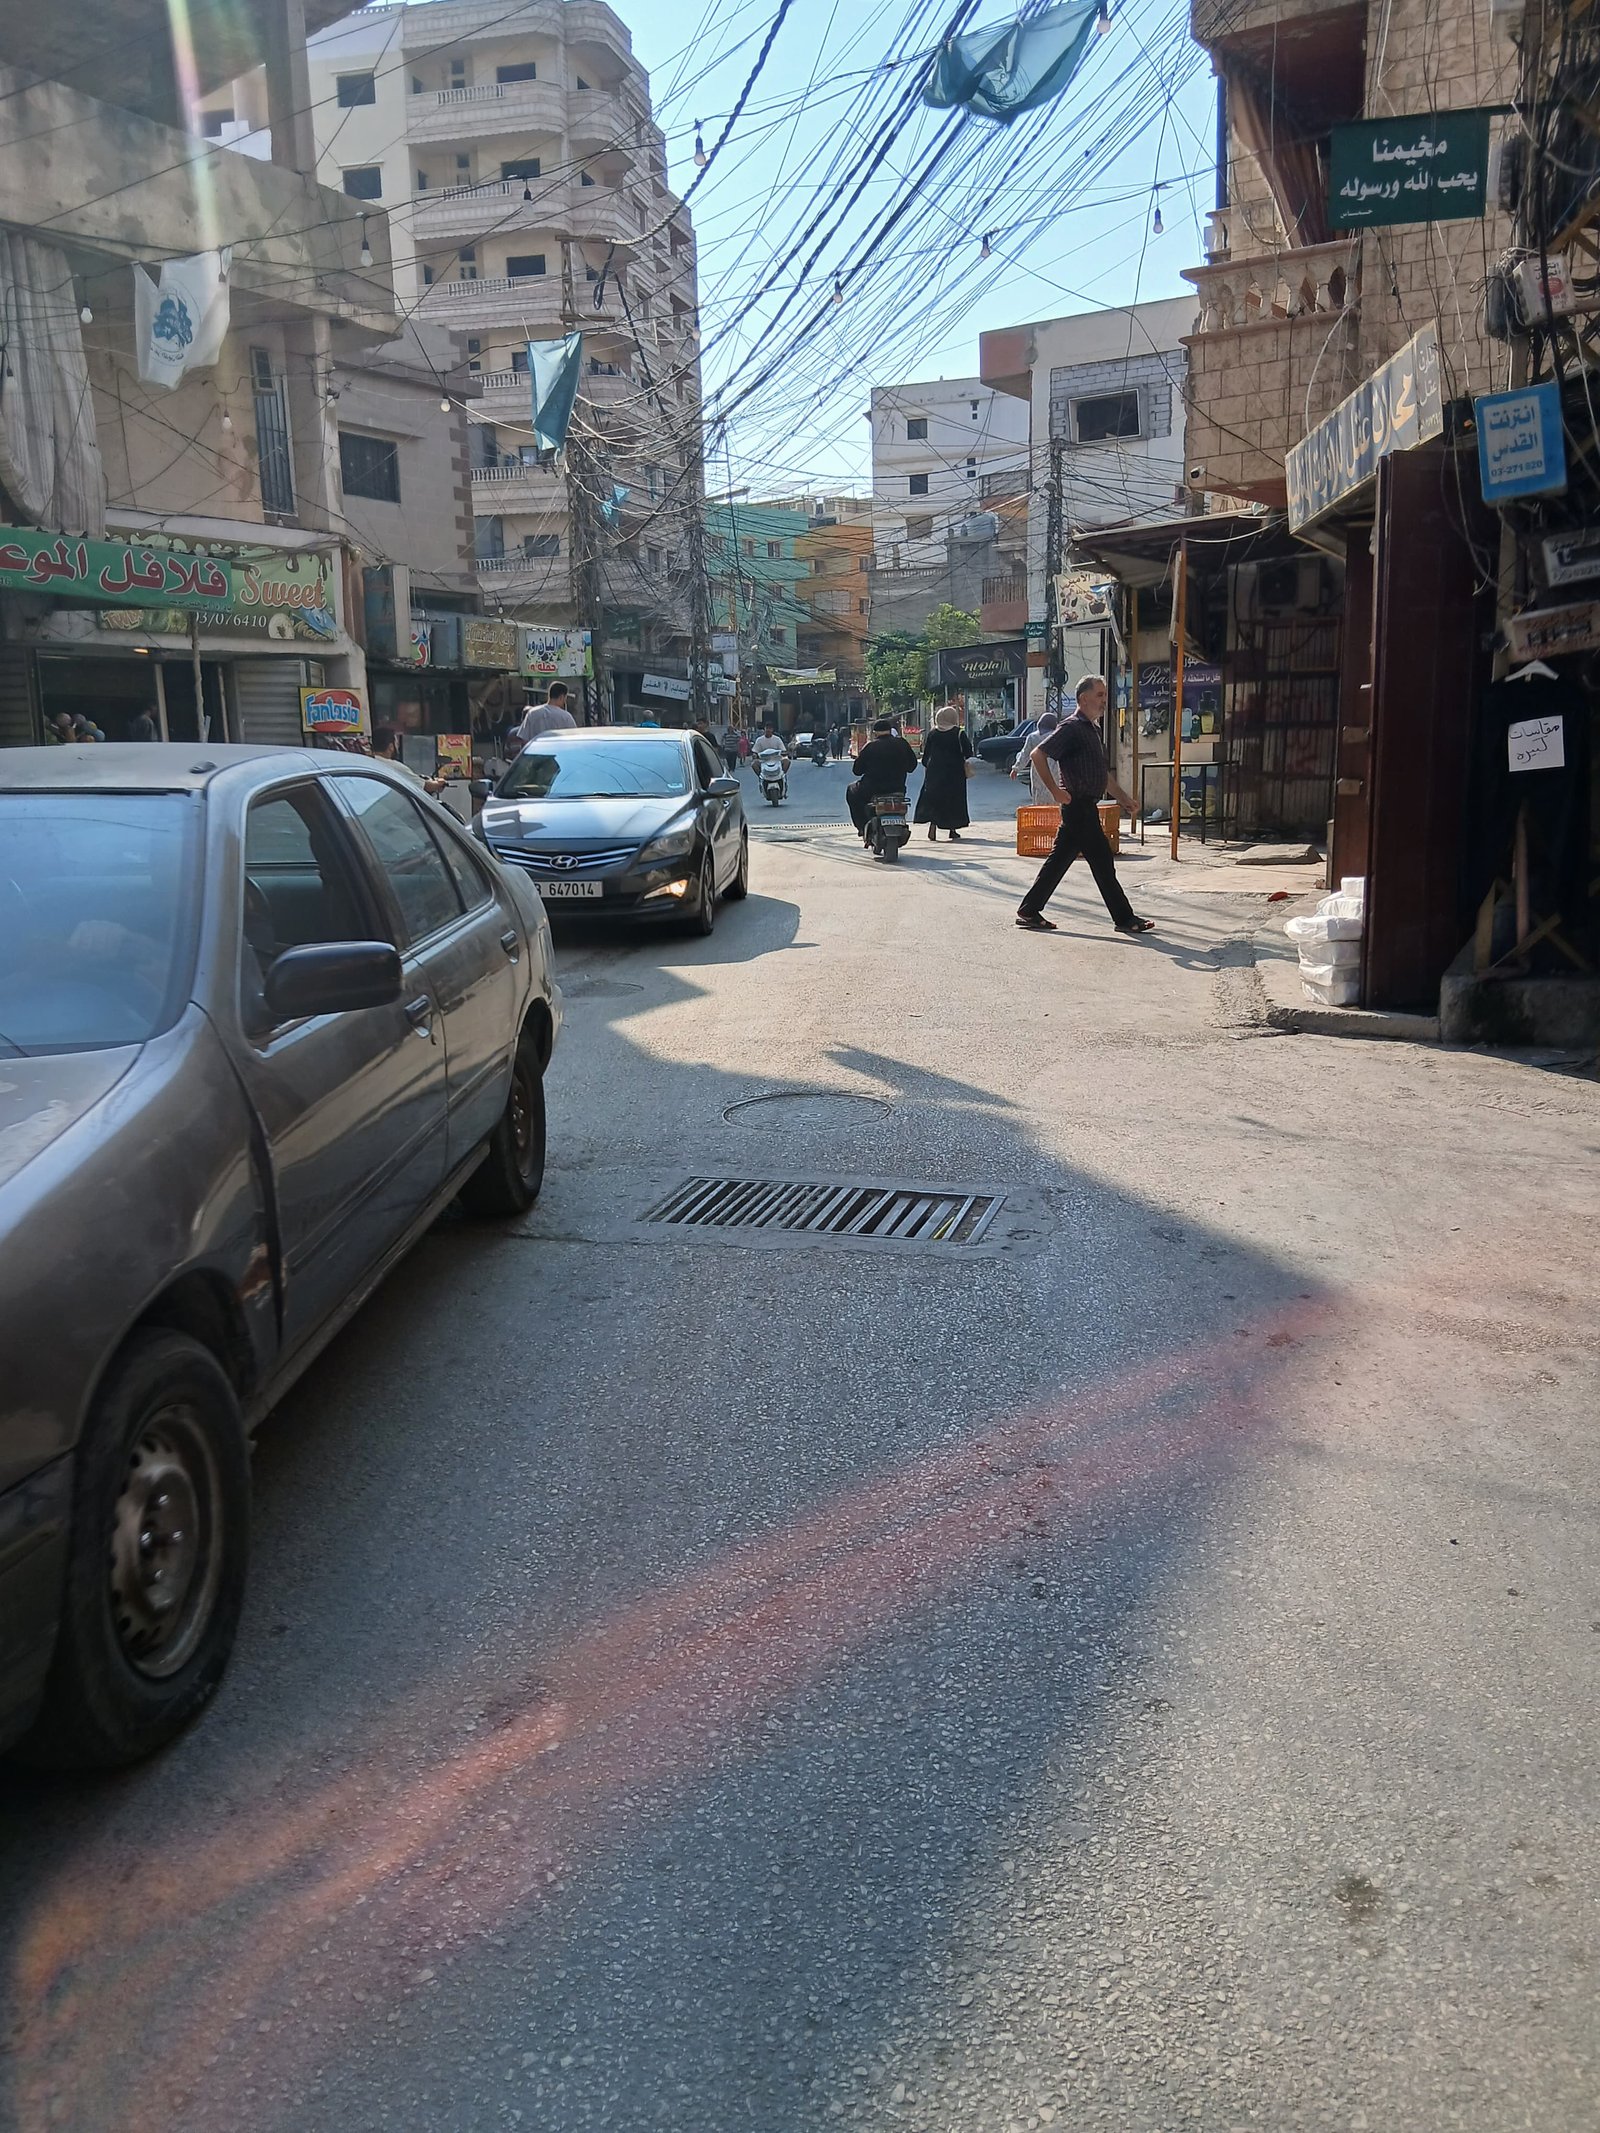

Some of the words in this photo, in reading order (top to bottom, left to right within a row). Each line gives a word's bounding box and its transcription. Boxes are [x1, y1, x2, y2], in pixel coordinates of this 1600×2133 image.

[1372, 134, 1448, 166] مخيمنا
[1340, 176, 1400, 201] ورسوله
[1404, 167, 1434, 191] الله
[1437, 170, 1478, 194] يحب
[1371, 372, 1417, 452] محلات
[1489, 404, 1535, 431] انترنت
[1492, 432, 1538, 462] القدس
[99, 549, 229, 599] فلافل
[240, 564, 330, 610] Sweet
[305, 694, 360, 727] Fantasia
[548, 882, 594, 896] 647014
